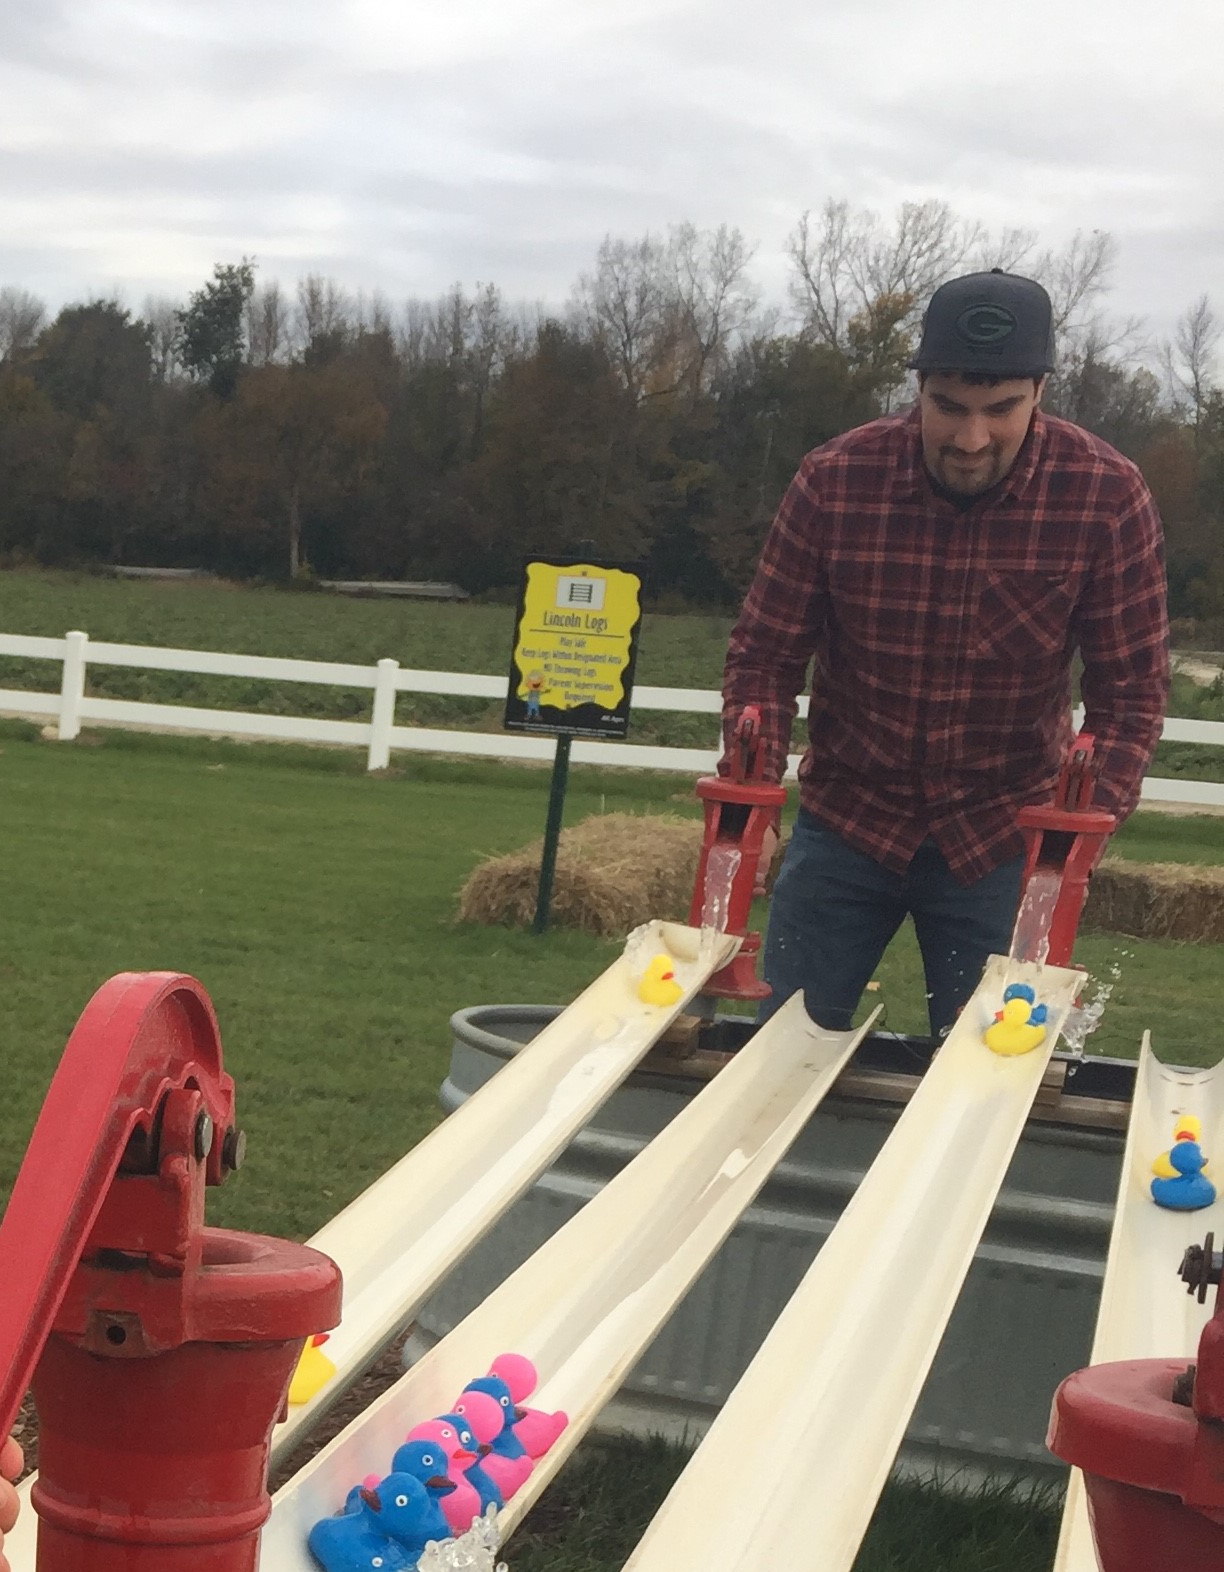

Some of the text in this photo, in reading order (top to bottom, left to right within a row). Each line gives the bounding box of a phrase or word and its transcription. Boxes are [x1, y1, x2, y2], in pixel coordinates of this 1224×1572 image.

[956, 305, 1013, 342] G
[543, 610, 608, 633] Lincoln Logs
